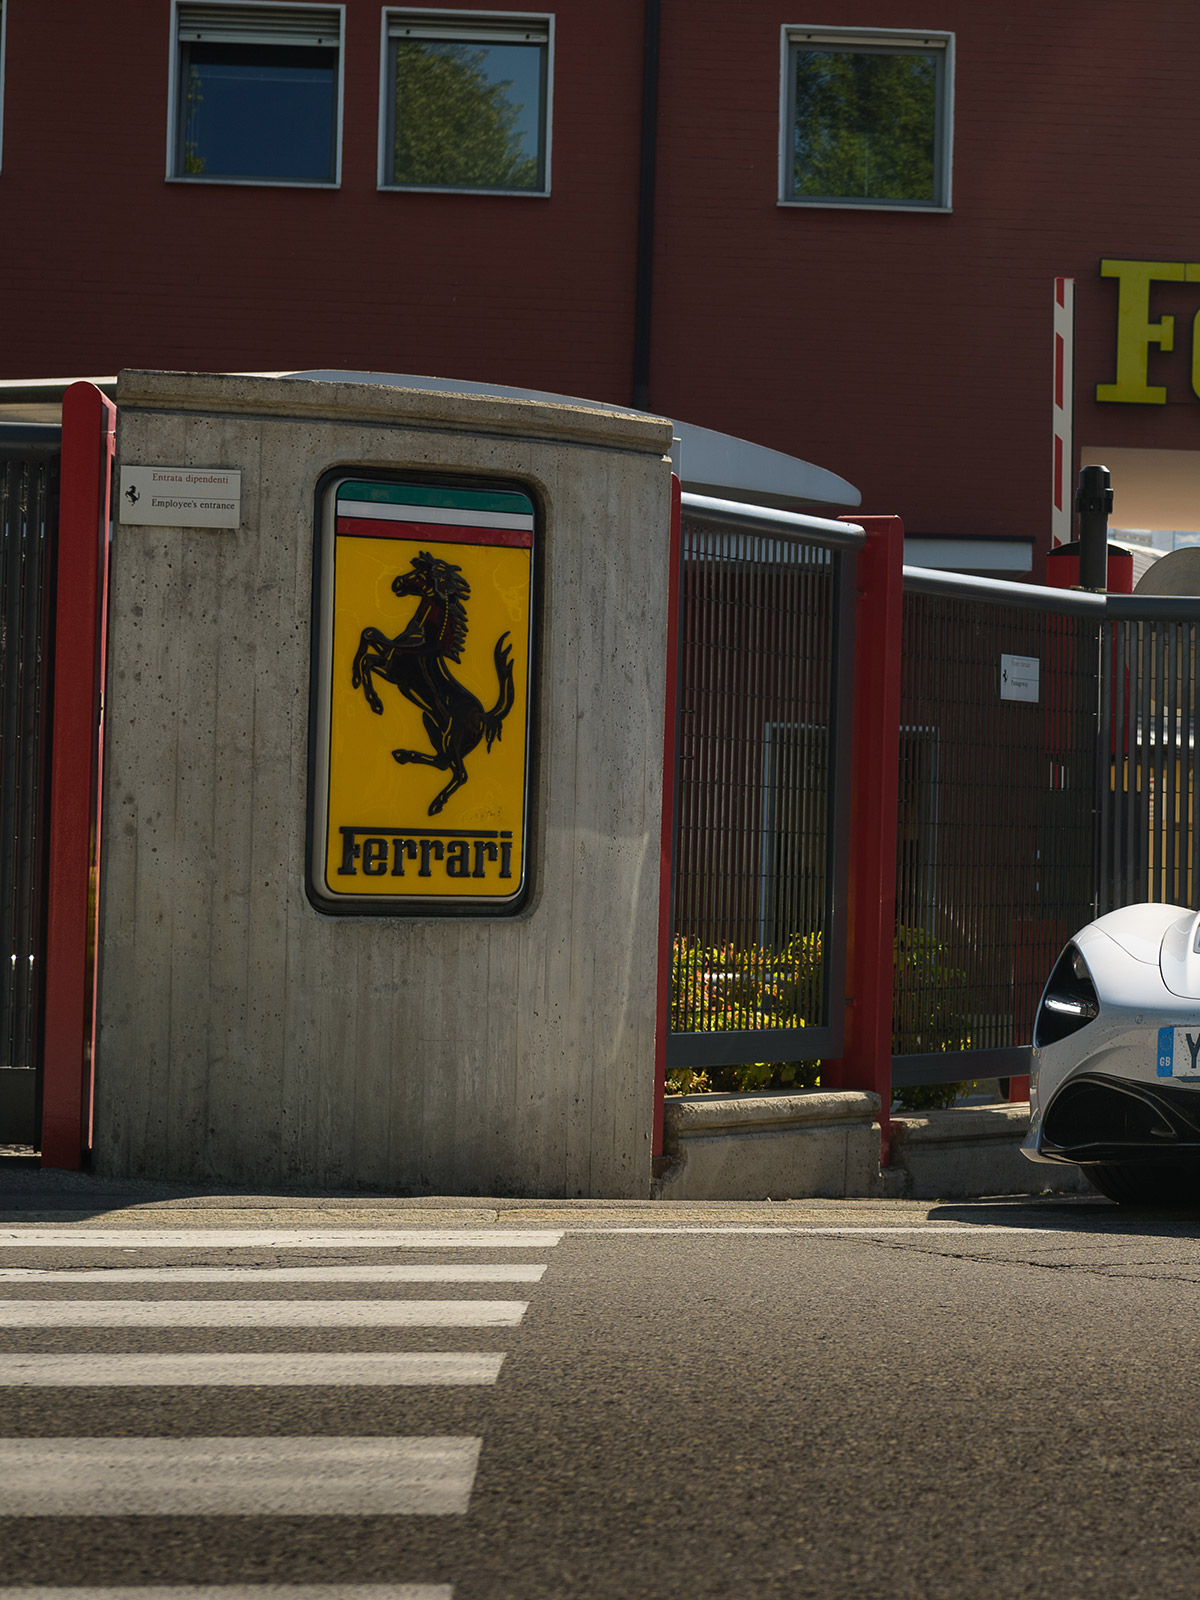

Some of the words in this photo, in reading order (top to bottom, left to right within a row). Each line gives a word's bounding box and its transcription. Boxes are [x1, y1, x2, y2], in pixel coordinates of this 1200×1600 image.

[152, 473, 183, 482] Entrata
[185, 475, 229, 484] dipendenti
[151, 498, 197, 509] Employee's
[200, 501, 235, 510] entrance
[337, 826, 513, 878] Ferrari
[1159, 1056, 1171, 1067] GB
